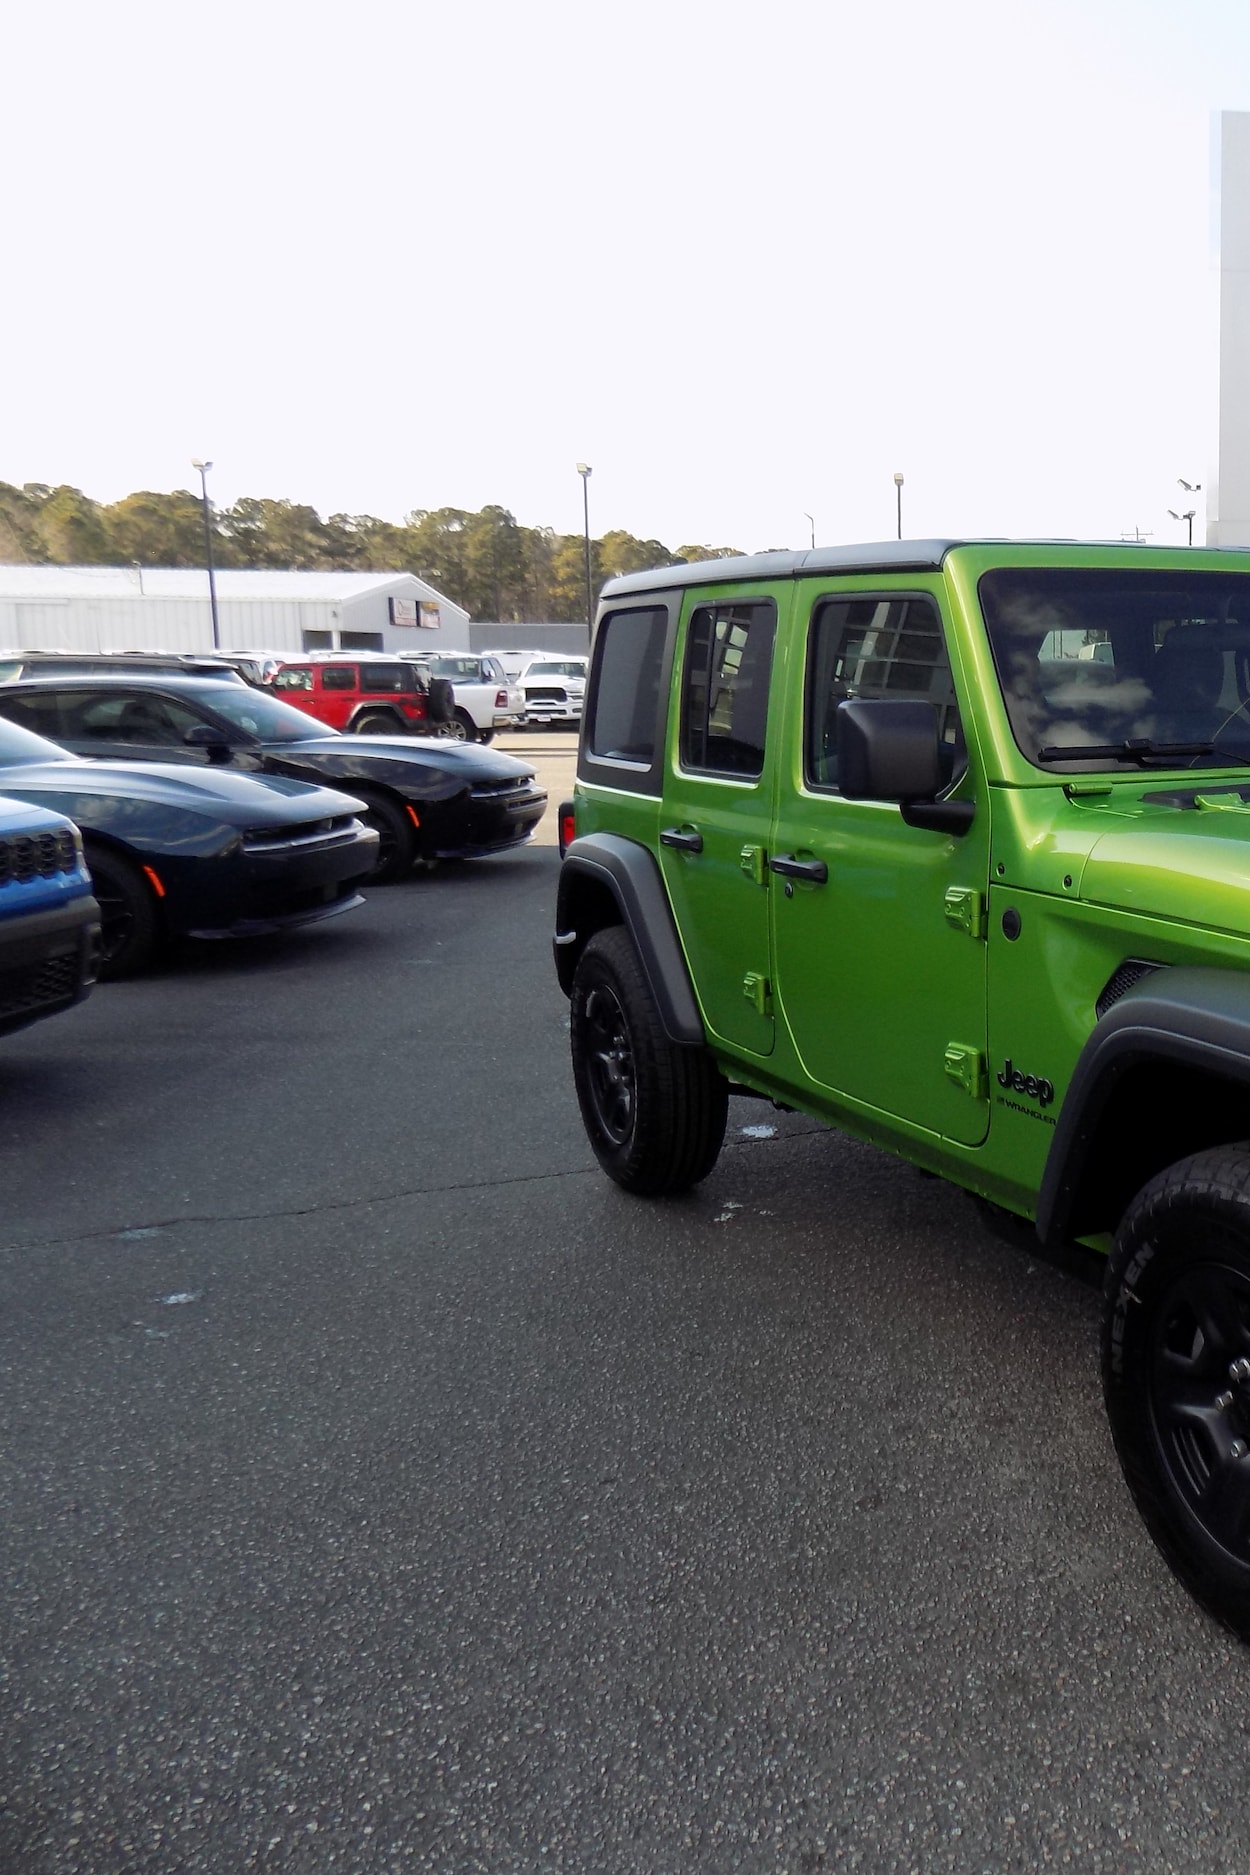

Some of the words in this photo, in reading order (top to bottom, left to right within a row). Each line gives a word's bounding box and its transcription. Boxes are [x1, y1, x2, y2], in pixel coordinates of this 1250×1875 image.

[997, 1058, 1054, 1108] Jeep
[1004, 1099, 1057, 1125] WRANGLER
[1112, 1240, 1156, 1375] NEXEN
